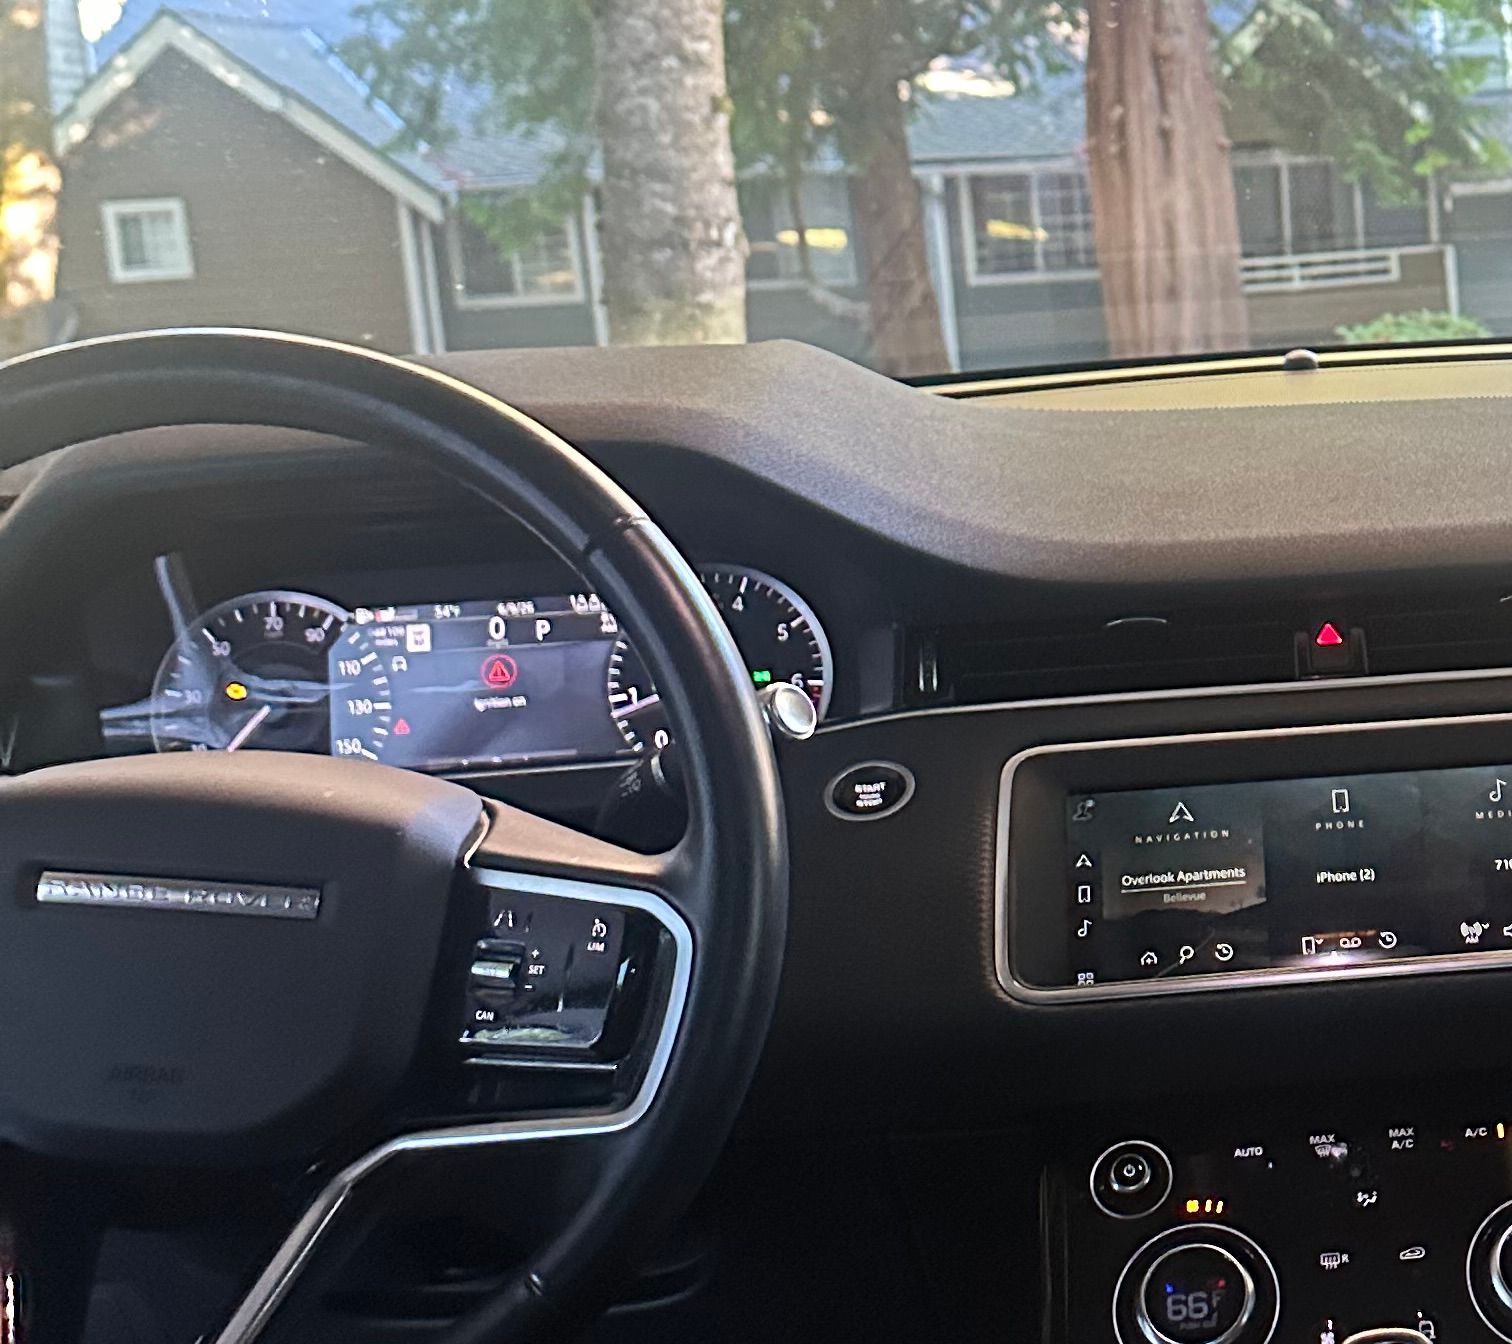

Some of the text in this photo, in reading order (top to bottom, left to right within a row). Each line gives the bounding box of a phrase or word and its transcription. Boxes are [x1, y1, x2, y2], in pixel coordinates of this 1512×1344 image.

[731, 596, 744, 612] 4
[263, 616, 284, 632] 70
[488, 616, 551, 641] 0 P
[304, 627, 326, 643] 90
[777, 624, 790, 642] 5
[211, 640, 231, 656] 50
[338, 659, 362, 676] 110
[791, 673, 805, 688] 6
[347, 699, 373, 715] 130
[336, 739, 362, 755] 150
[654, 730, 669, 749] 0
[1315, 819, 1365, 831] PHONE
[1134, 829, 1230, 844] NAVIGATION
[1121, 866, 1246, 887] Overlook Apartments
[1316, 868, 1376, 884] iPhone (2)
[1163, 891, 1207, 904] Bellevue
[528, 964, 545, 975] SET
[475, 1010, 494, 1021] CAN
[1309, 1134, 1336, 1145] MAX
[1388, 1127, 1415, 1138] MAX
[1465, 1127, 1488, 1138] A/C
[1234, 1146, 1263, 1158] AUTO
[1391, 1139, 1414, 1150] A/C
[1166, 1291, 1209, 1322] 66
